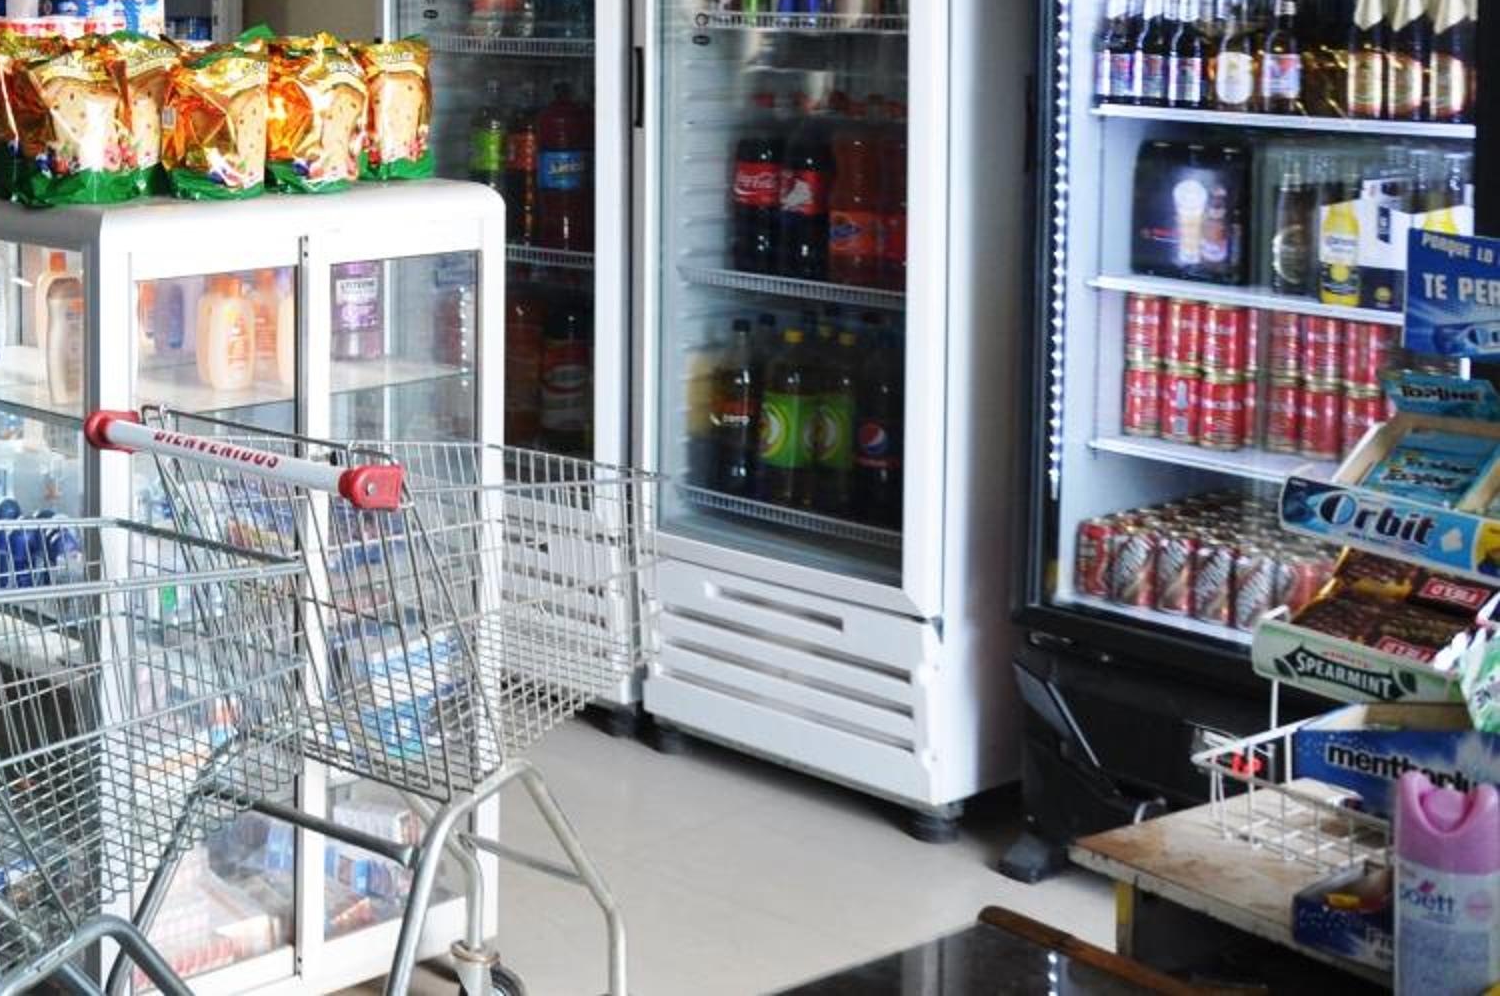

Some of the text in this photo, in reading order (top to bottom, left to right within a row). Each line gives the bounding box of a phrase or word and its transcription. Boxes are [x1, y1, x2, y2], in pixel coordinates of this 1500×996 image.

[1422, 272, 1448, 300] TE
[1319, 491, 1435, 546] Orbit
[1296, 651, 1393, 699] SPEARMINT
